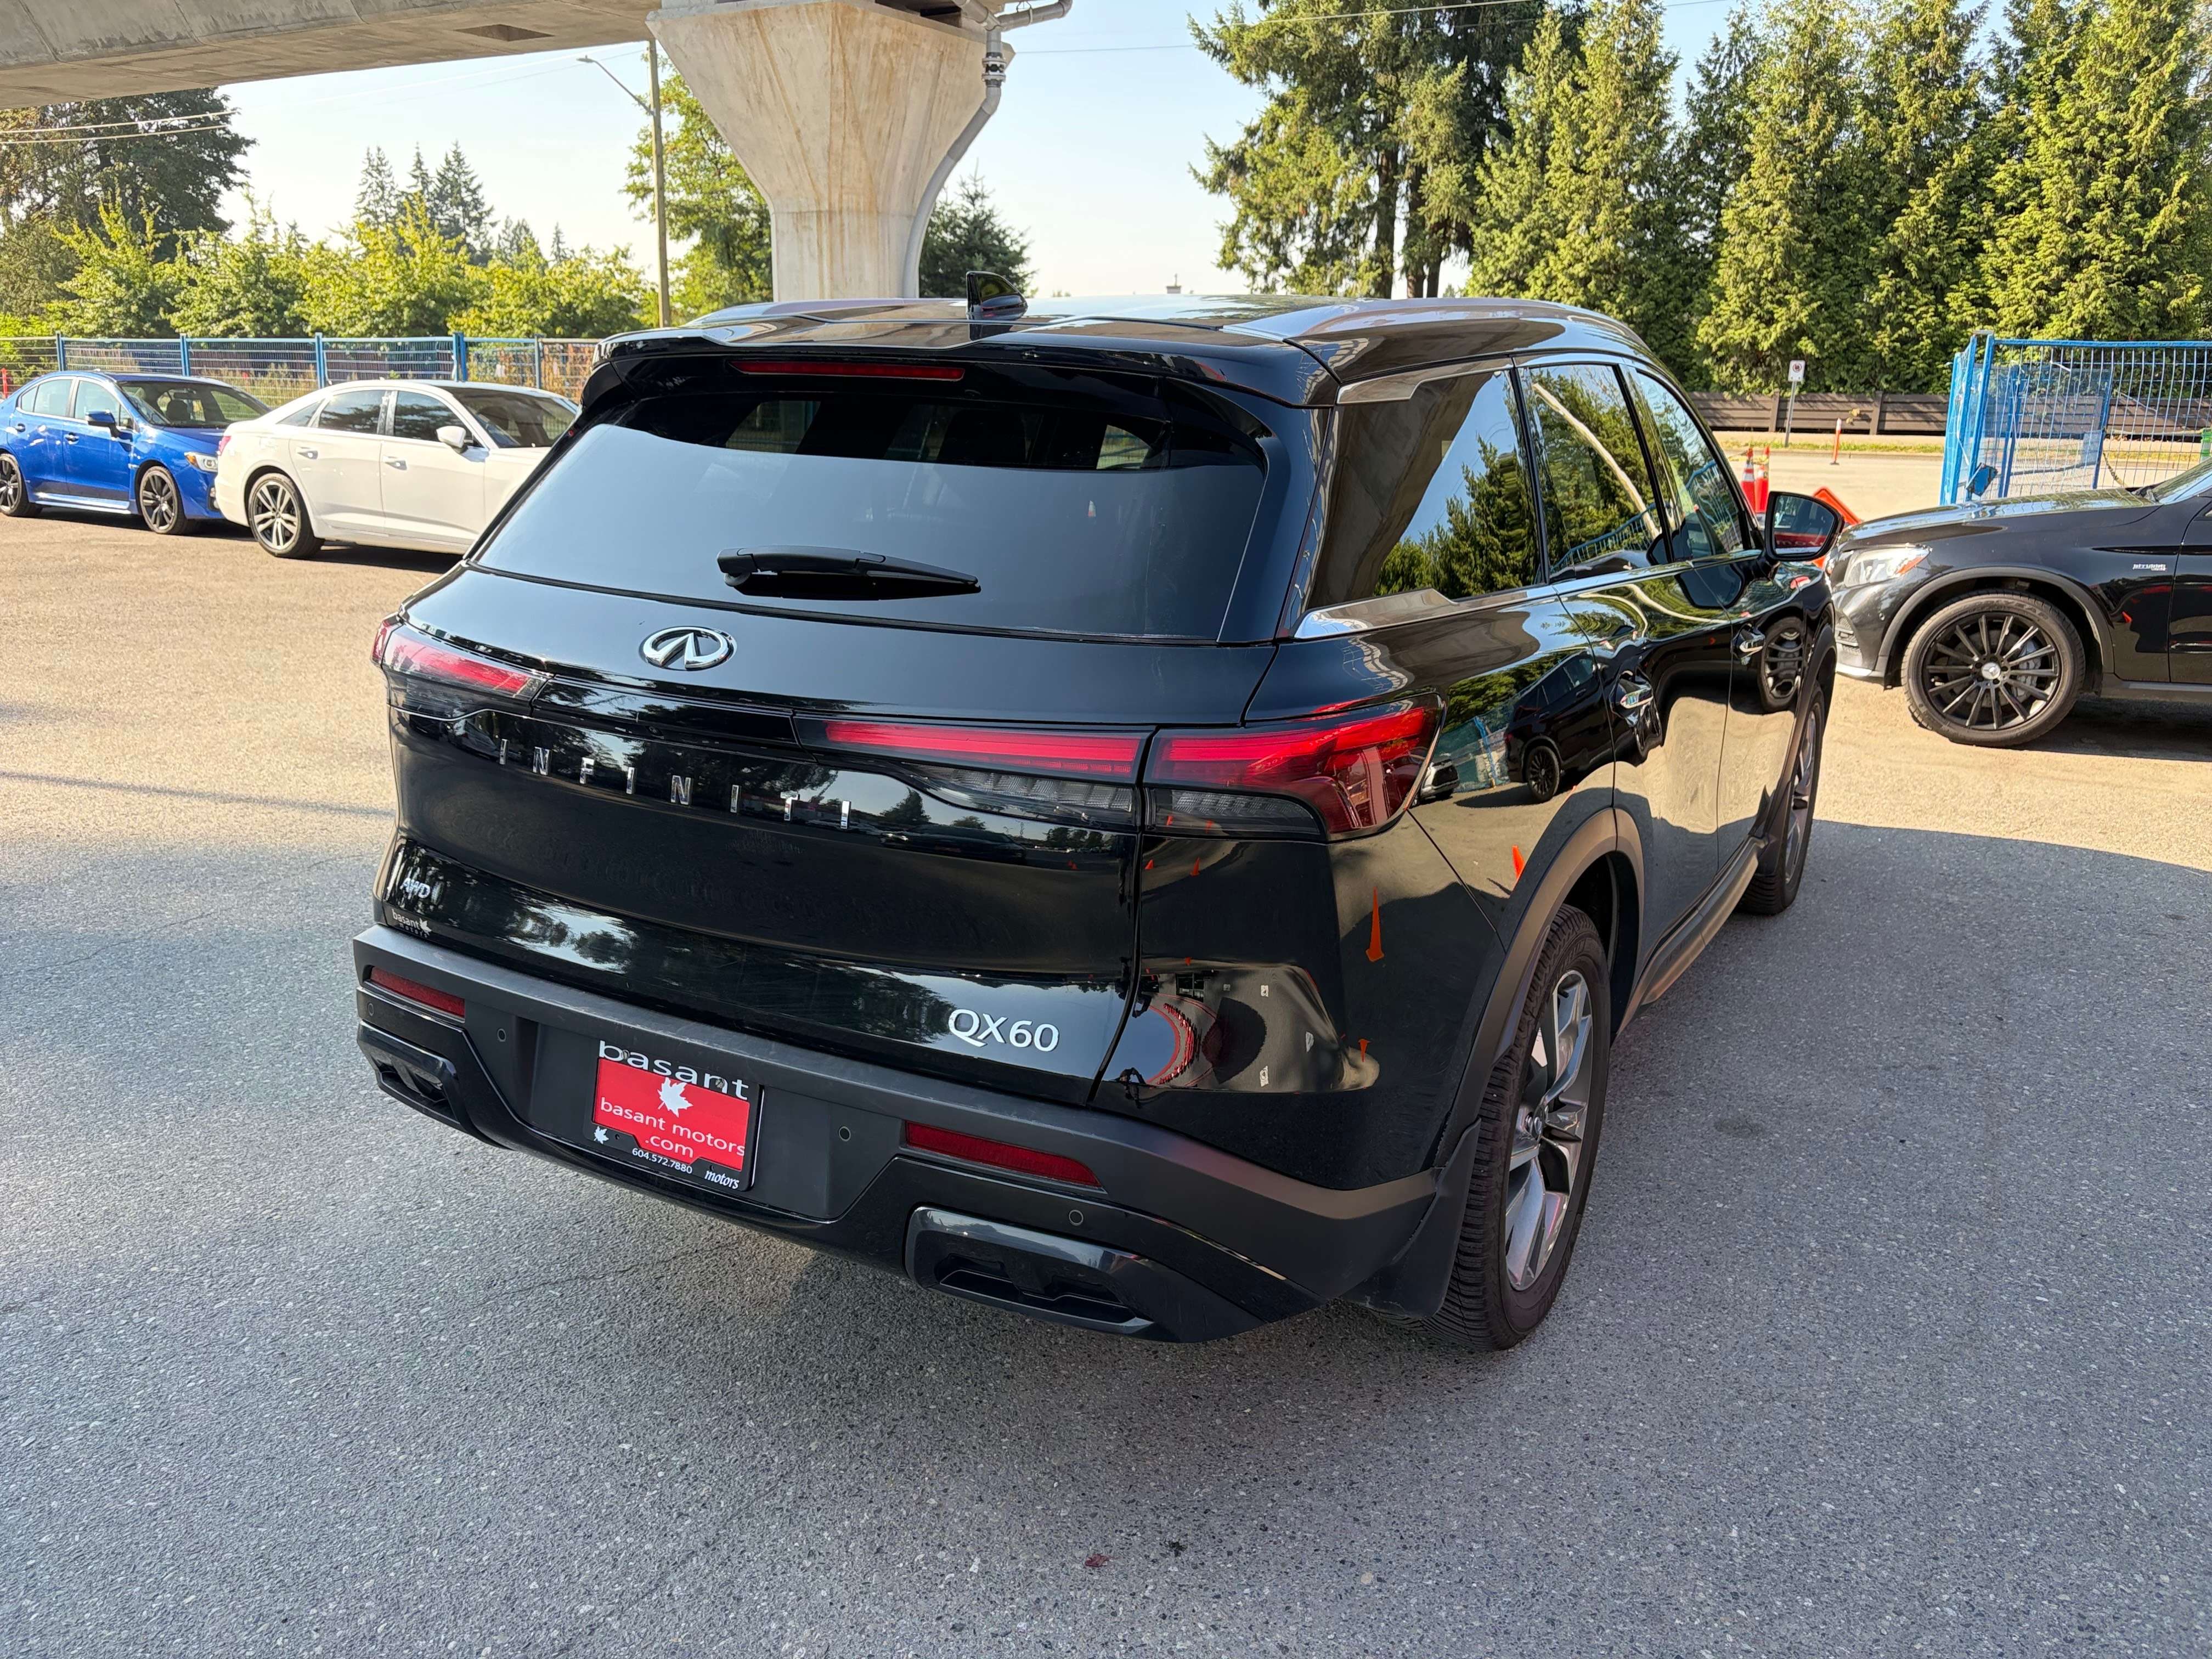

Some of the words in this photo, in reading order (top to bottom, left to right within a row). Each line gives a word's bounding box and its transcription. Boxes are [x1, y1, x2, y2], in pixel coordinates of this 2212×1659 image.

[499, 738, 852, 830] INFINITI
[400, 878, 431, 900] AWD
[392, 908, 420, 930] basant
[948, 1009, 1060, 1052] QX60
[599, 1040, 749, 1101] basant
[601, 1097, 666, 1131] basant
[672, 1123, 745, 1156] motors
[645, 1135, 694, 1158] .com
[631, 1147, 693, 1174] 604.572.7880
[704, 1170, 740, 1189] motors
